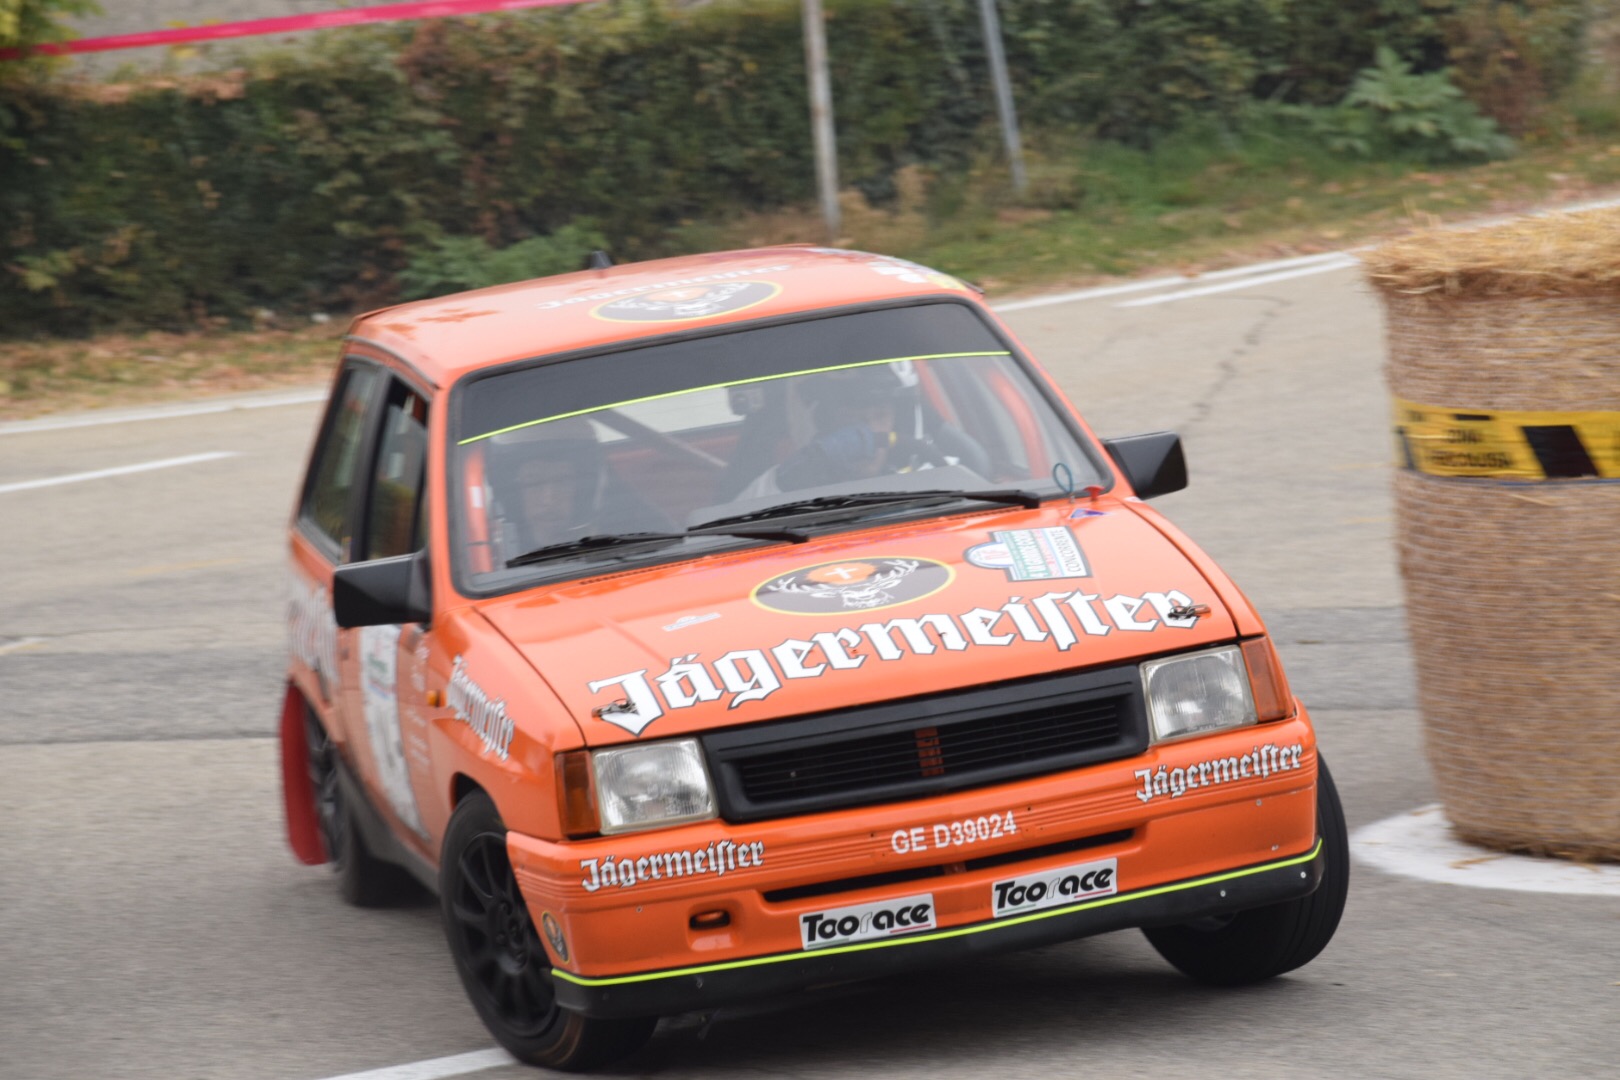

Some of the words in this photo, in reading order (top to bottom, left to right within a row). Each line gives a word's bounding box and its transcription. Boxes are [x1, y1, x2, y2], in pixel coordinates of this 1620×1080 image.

[1134, 742, 1303, 802] Jägermeister
[891, 826, 927, 854] GE
[935, 810, 1017, 849] D39024
[580, 840, 765, 892] Jägermeister
